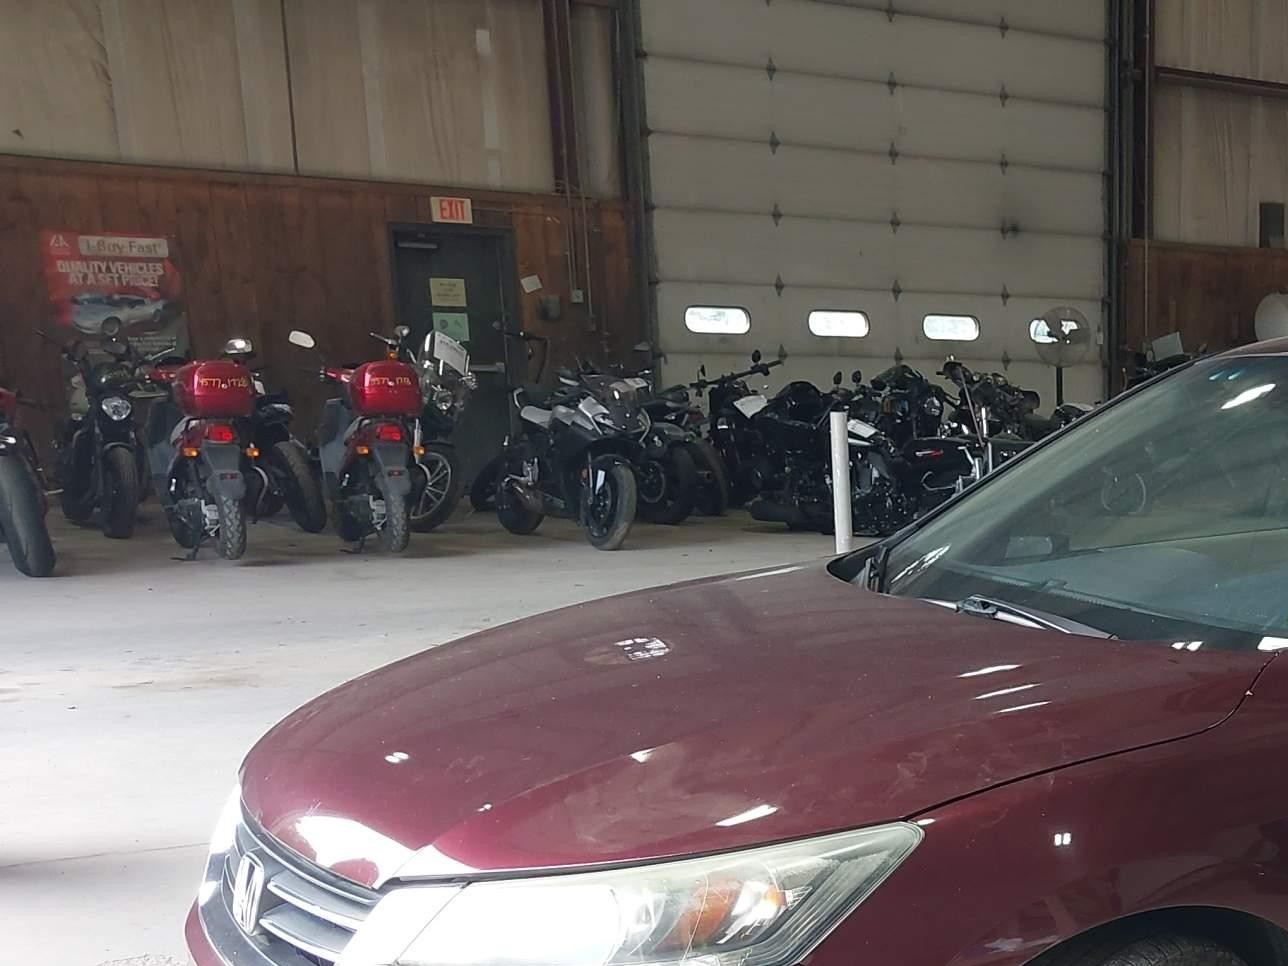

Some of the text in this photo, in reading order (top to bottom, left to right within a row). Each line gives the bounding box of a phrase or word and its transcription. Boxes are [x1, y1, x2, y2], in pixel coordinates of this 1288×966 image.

[440, 199, 465, 220] EXIT
[128, 241, 158, 254] Fast
[56, 260, 164, 275] QUALITY VEHICLES
[69, 273, 159, 287] AT A SET PRICE!
